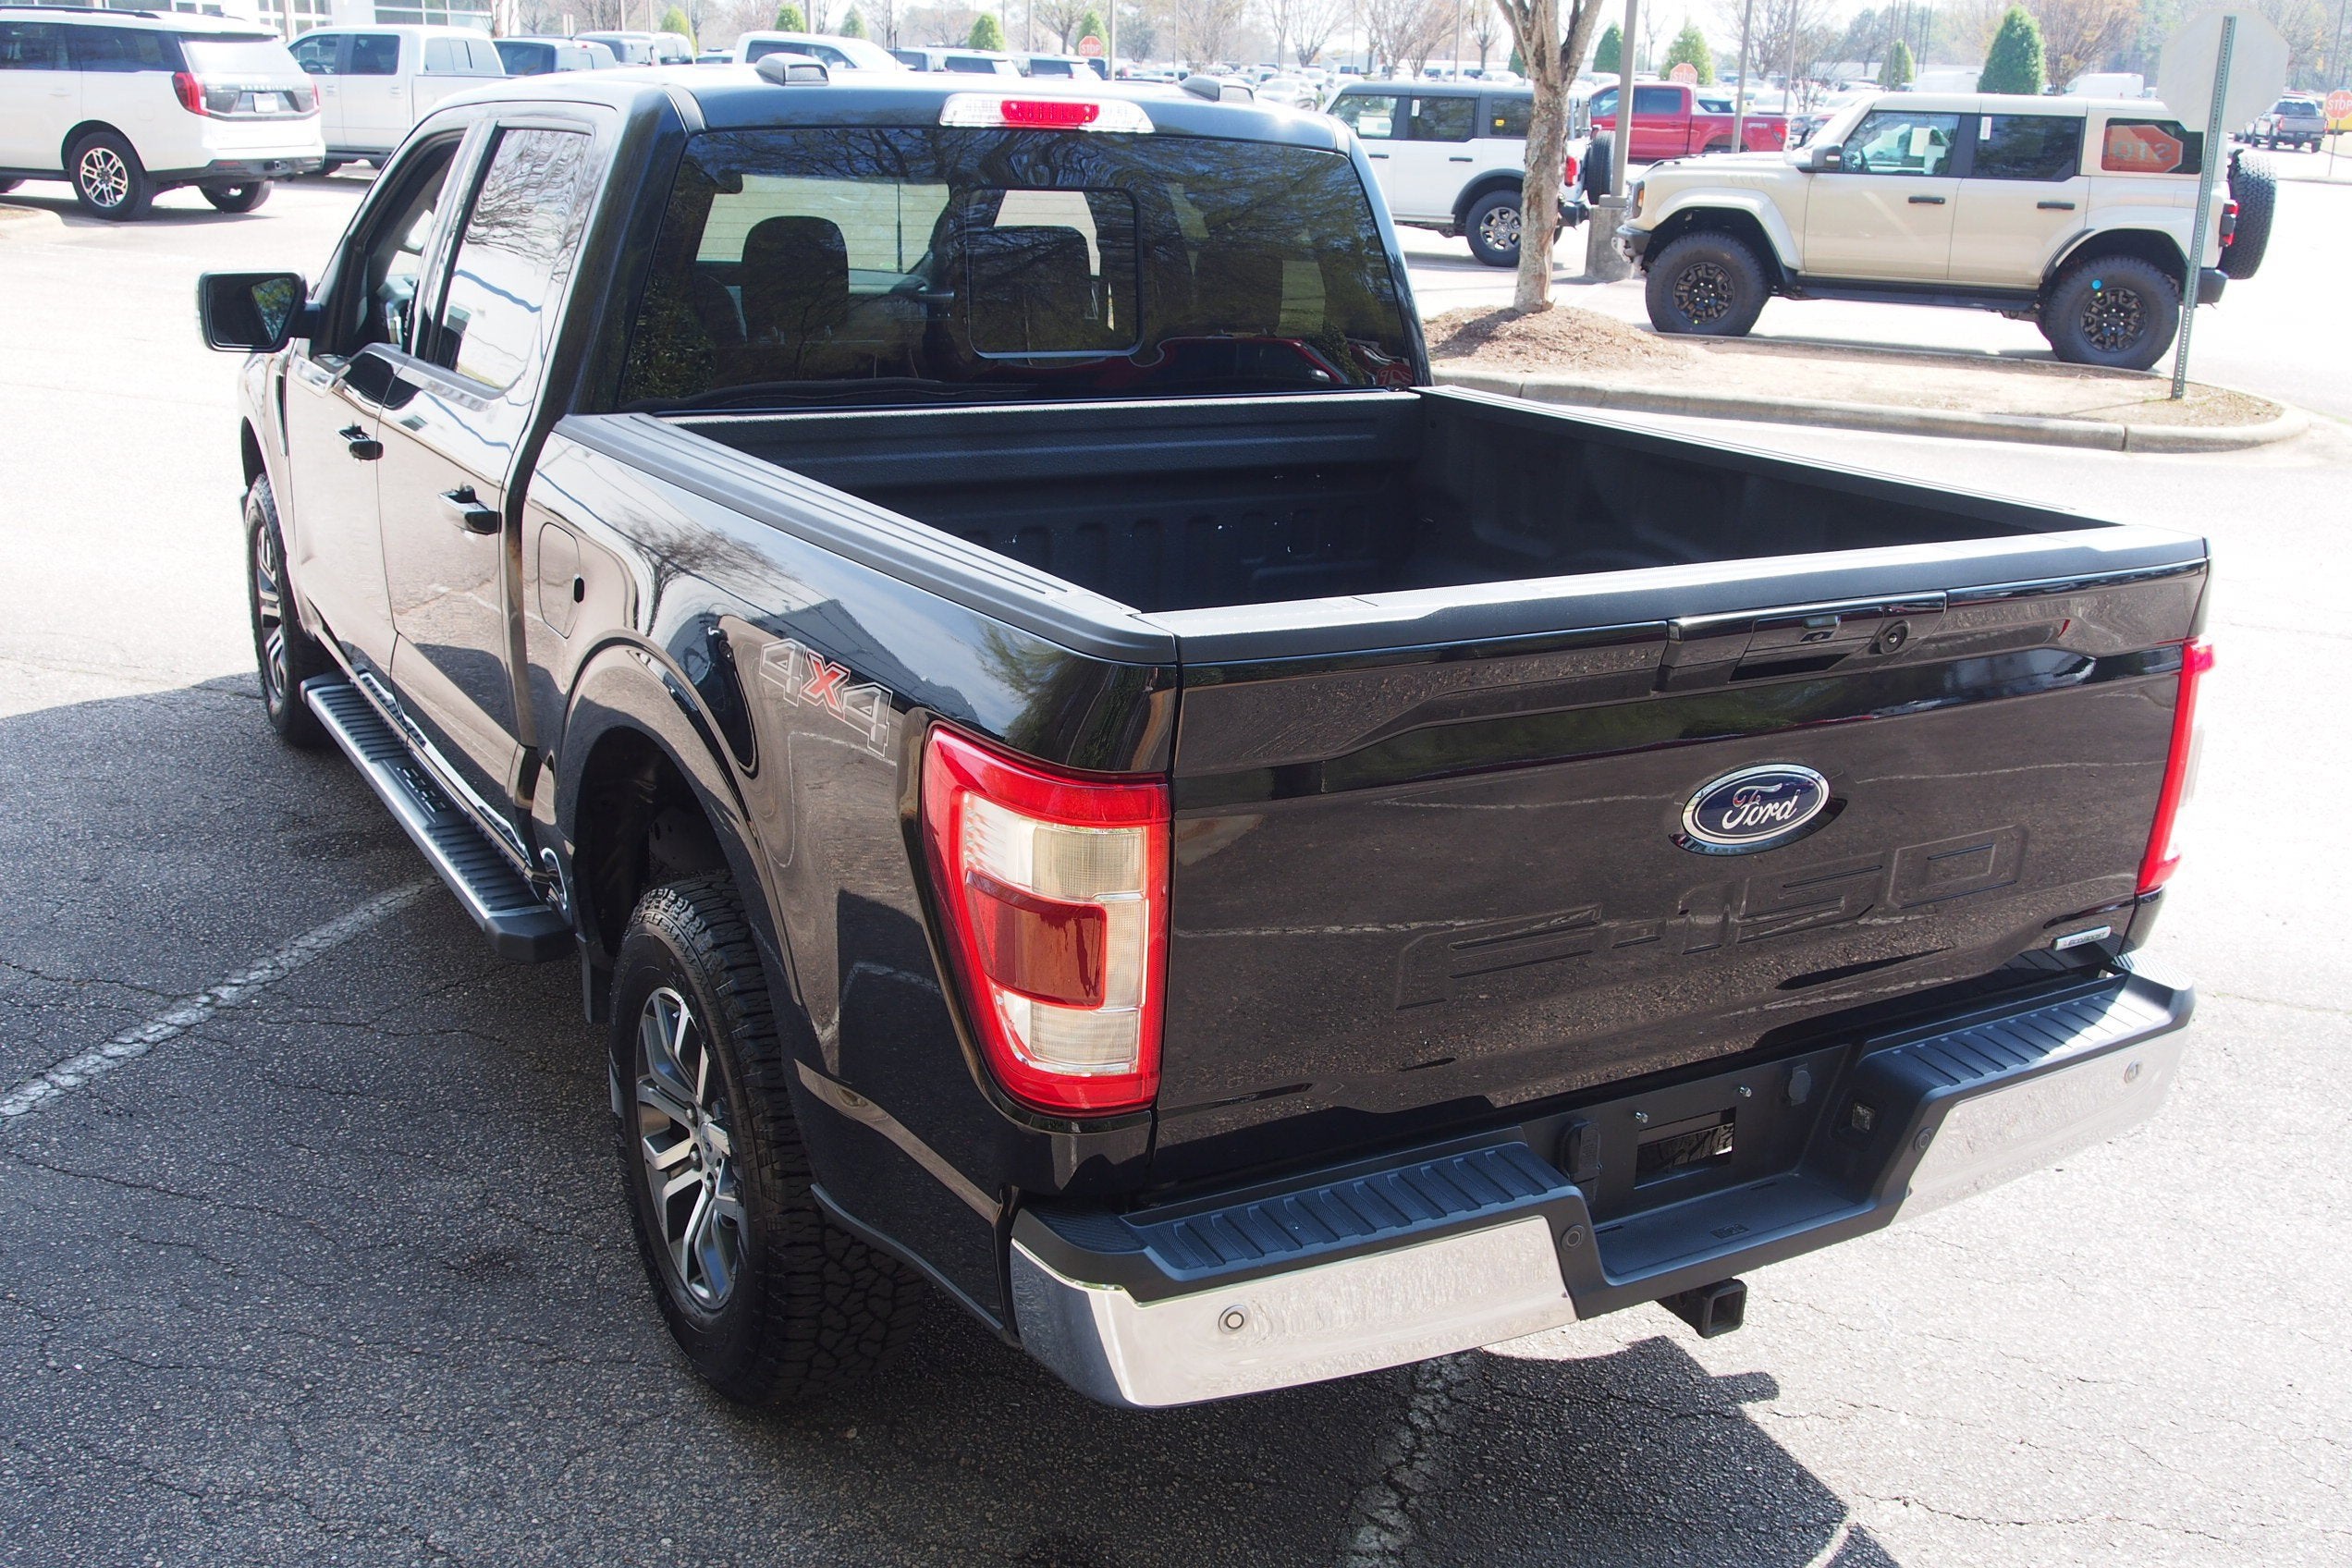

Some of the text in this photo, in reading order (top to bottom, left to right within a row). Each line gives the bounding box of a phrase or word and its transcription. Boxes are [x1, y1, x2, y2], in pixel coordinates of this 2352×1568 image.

[1081, 43, 1100, 55] STOP
[1672, 72, 1696, 81] STOP
[1721, 783, 1801, 829] Ford
[1395, 824, 2029, 1010] F-150
